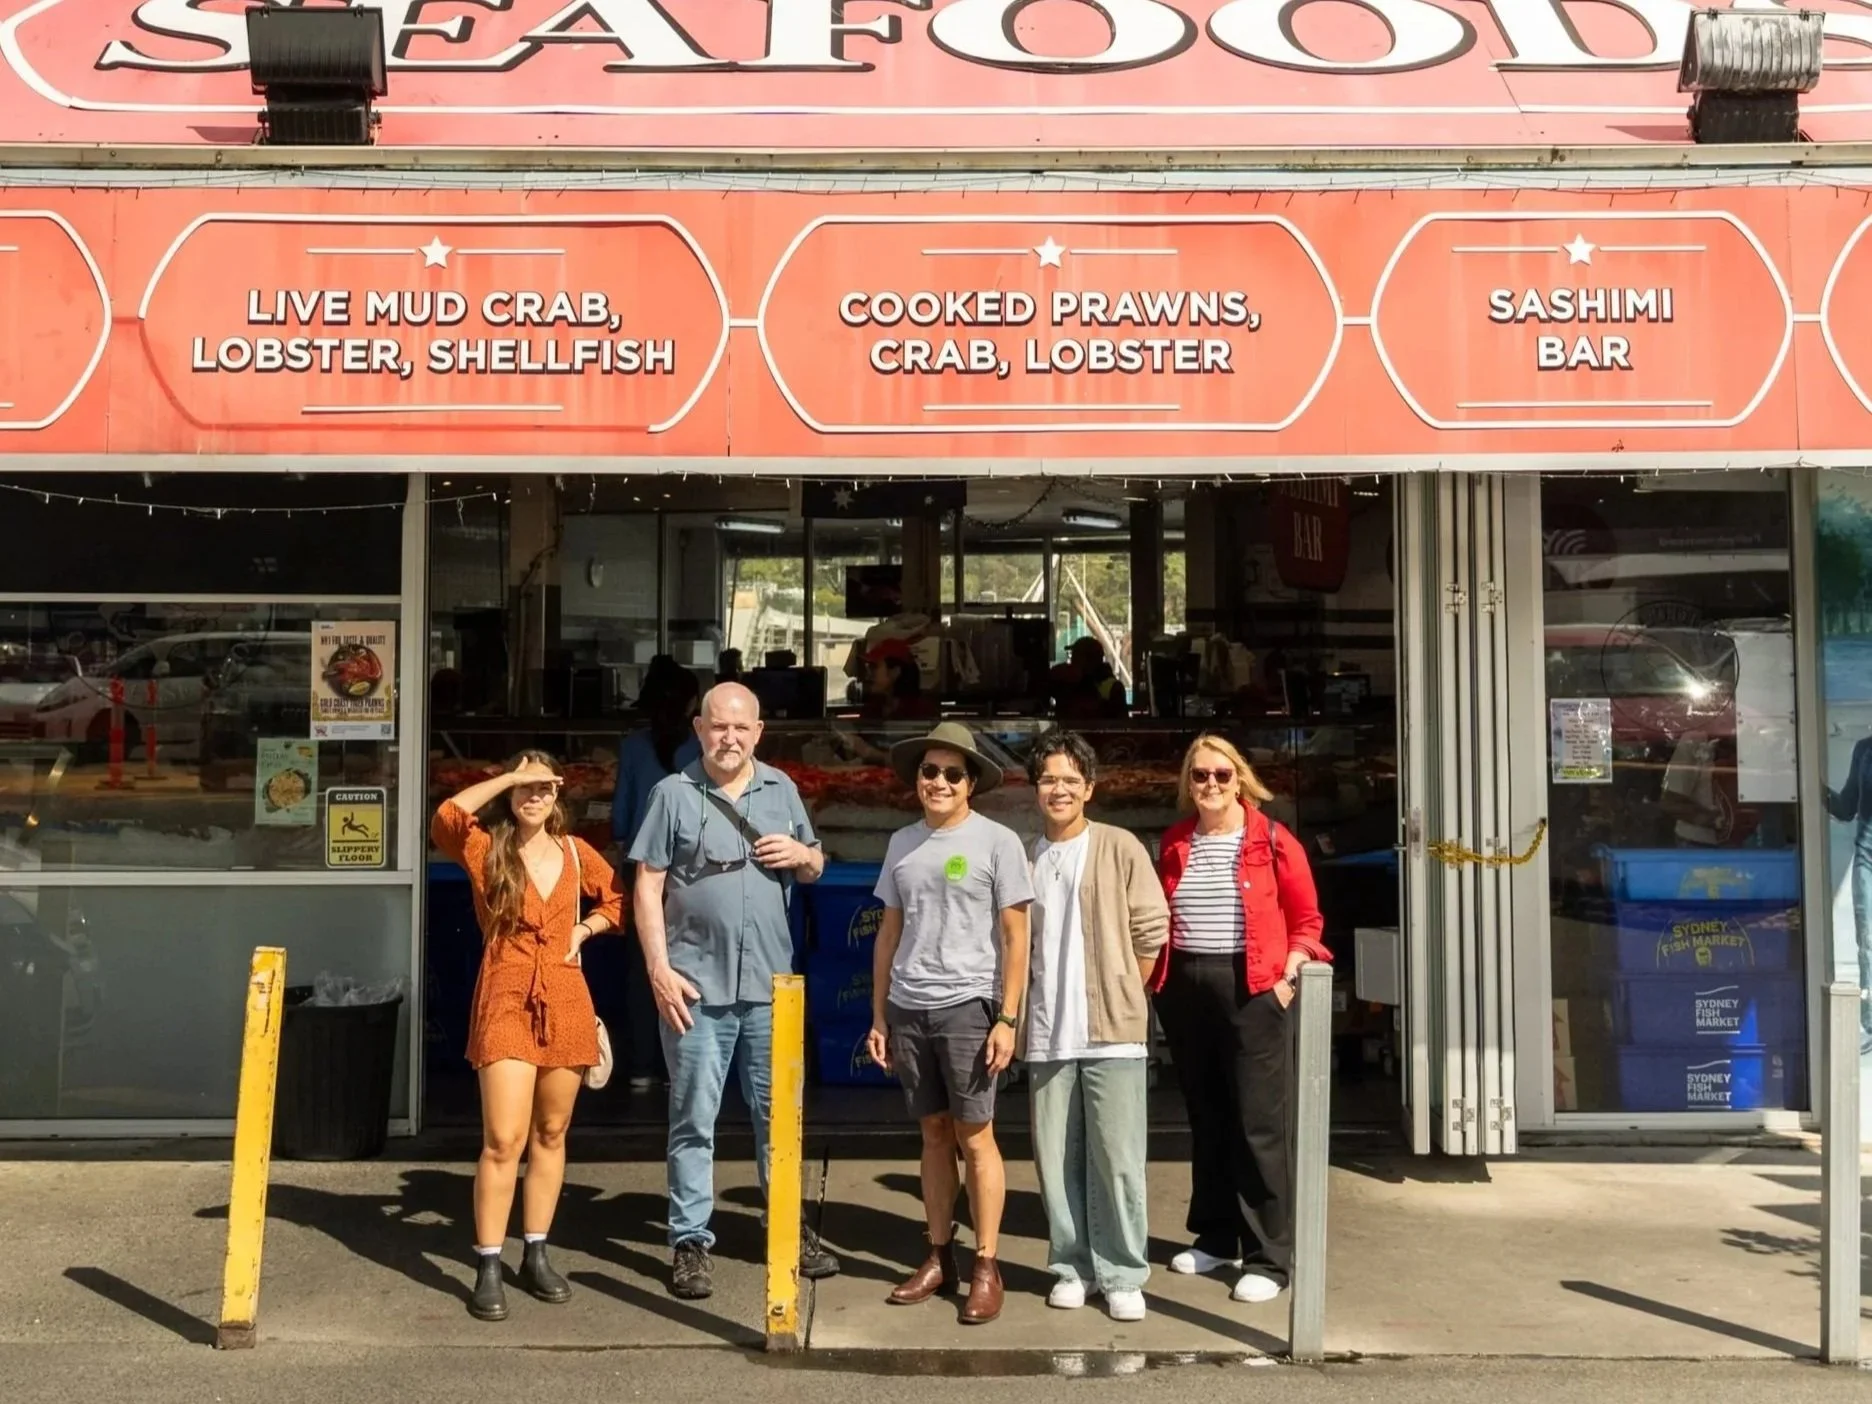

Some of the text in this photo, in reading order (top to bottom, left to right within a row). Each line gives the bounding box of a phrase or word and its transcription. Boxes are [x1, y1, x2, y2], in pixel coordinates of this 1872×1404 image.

[248, 289, 622, 332] LIVE MUD CRAB,
[839, 291, 1261, 332] COOKED PRAWNS,
[1488, 288, 1673, 323] SASHIMI
[192, 337, 675, 380] LOBSTER, SHELLFISH
[870, 338, 1235, 380] CRAB, LOBSTER
[1537, 336, 1633, 371] BAR
[1293, 511, 1323, 562] BAR
[1672, 921, 1728, 938] SYDNEY
[1661, 934, 1745, 956] FISH MARKET
[1695, 999, 1739, 1009] SYDNEY
[1695, 1008, 1720, 1017] FISH
[1696, 1017, 1740, 1027] MARKET
[1687, 1073, 1731, 1083] SYDNEY
[1687, 1082, 1711, 1092] FISH
[1688, 1091, 1732, 1101] MARKET
